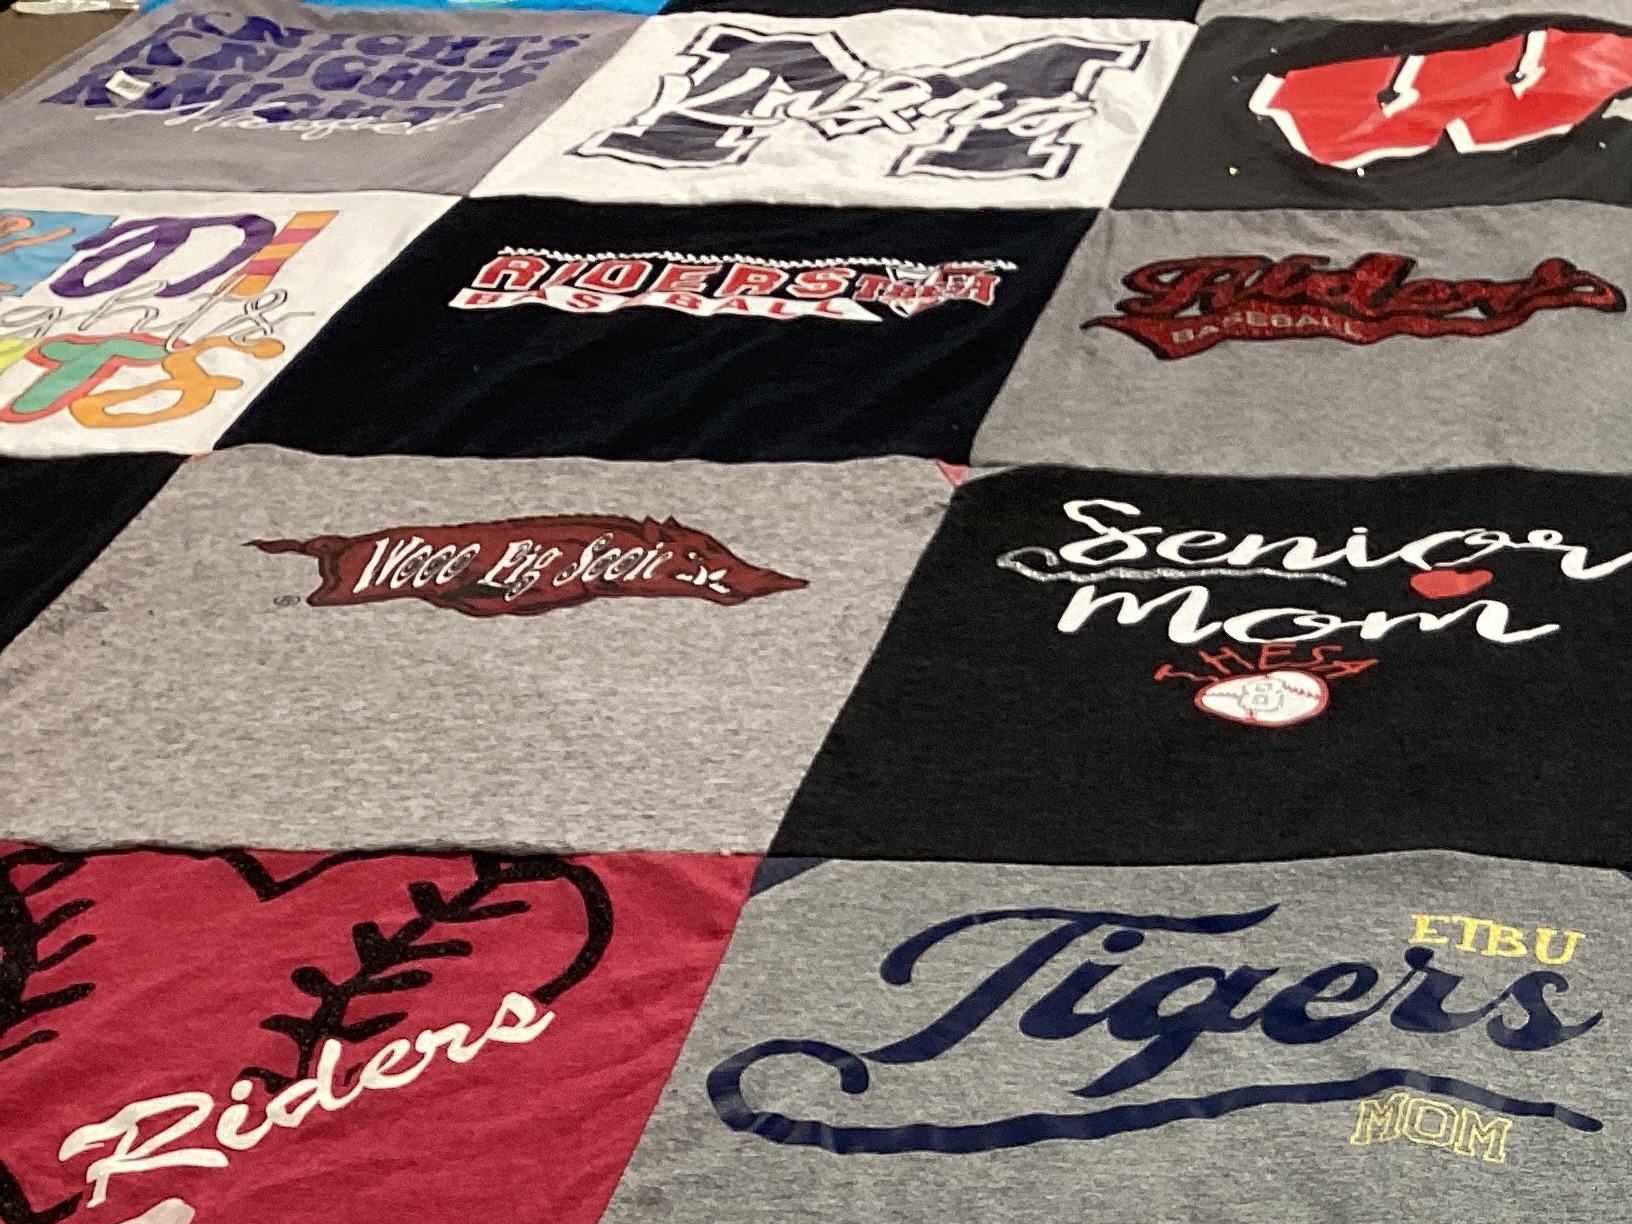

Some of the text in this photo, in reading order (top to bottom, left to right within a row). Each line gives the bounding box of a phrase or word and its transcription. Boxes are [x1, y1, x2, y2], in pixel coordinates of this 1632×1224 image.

[470, 254, 856, 299] RIDERS
[478, 540, 563, 602] Pig
[1408, 913, 1586, 964] ETBU
[861, 904, 1603, 1099] Tigers
[58, 992, 556, 1208] Riders
[1349, 1093, 1513, 1162] MOM
